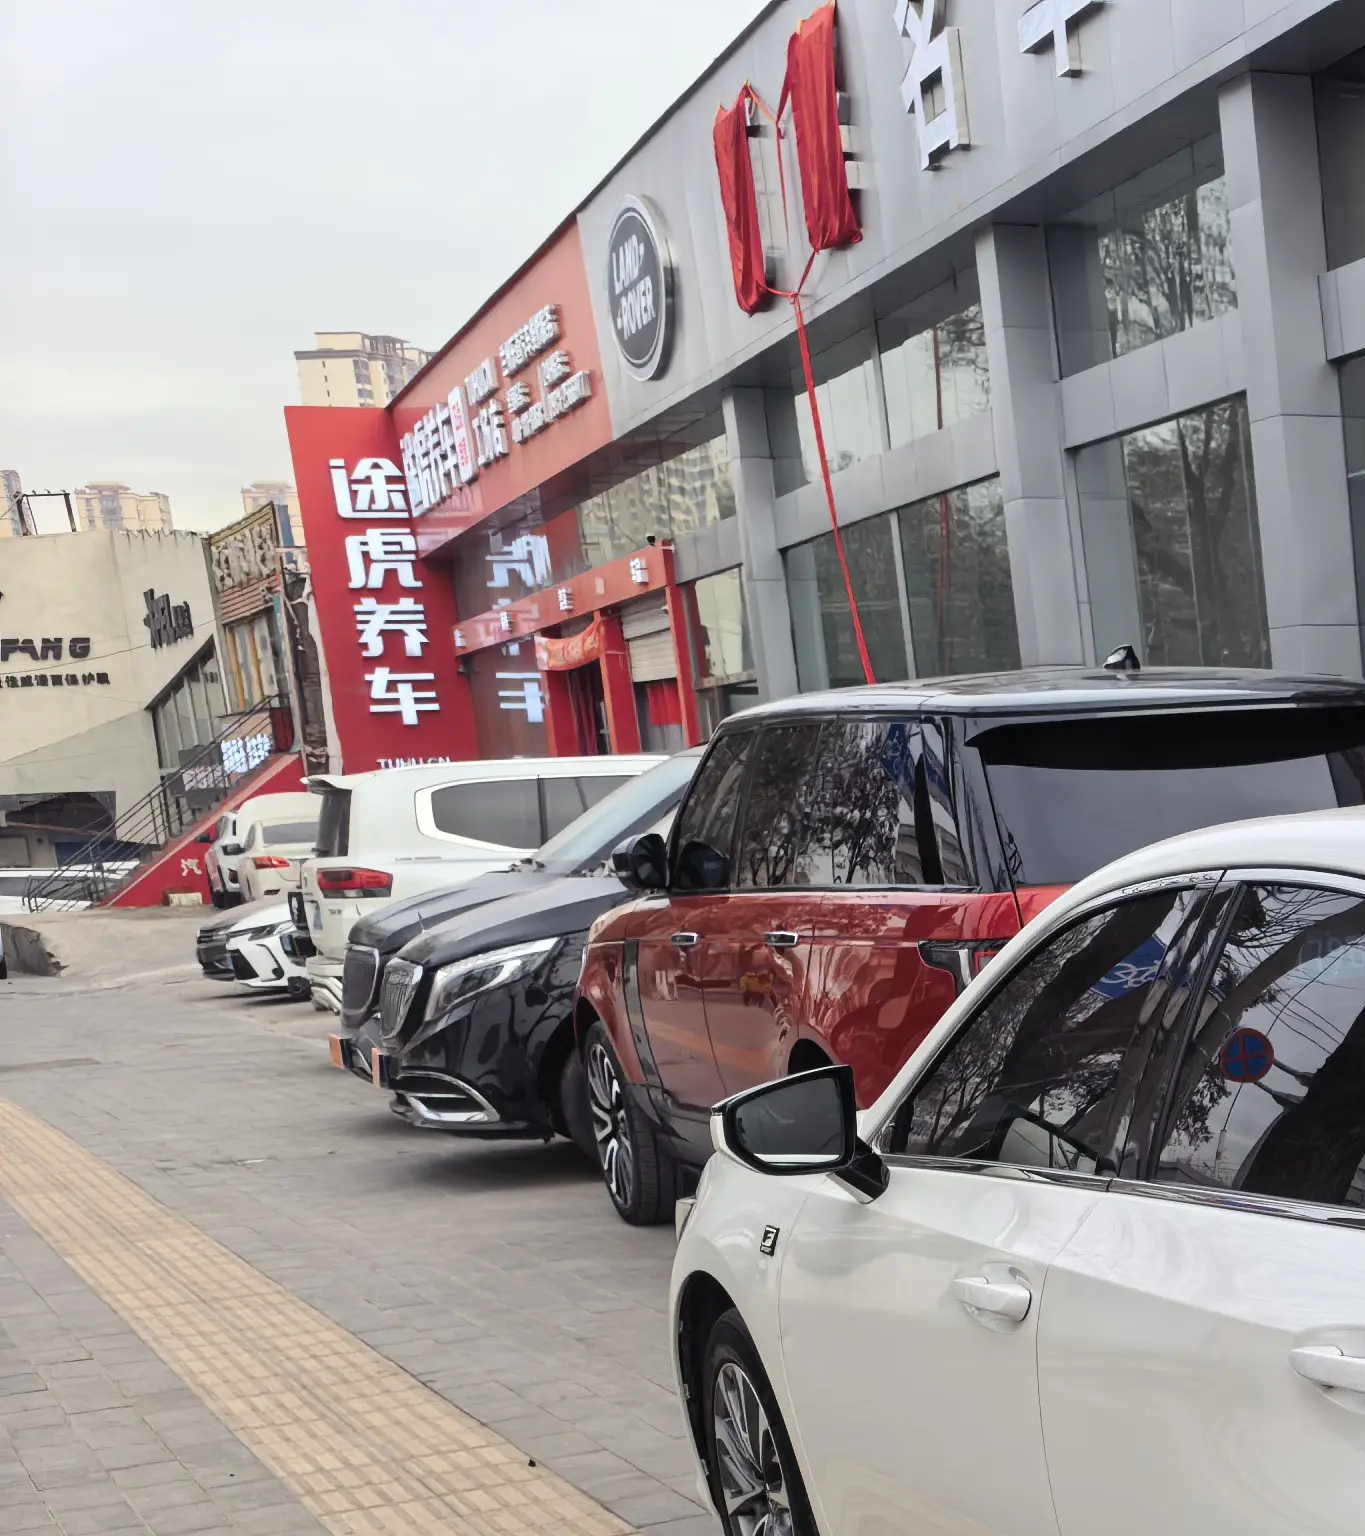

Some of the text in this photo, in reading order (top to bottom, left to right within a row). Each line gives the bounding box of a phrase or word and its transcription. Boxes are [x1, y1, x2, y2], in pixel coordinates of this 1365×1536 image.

[612, 234, 639, 295] LAND
[620, 276, 656, 340] ROVER
[329, 457, 441, 726] 途虎养车
